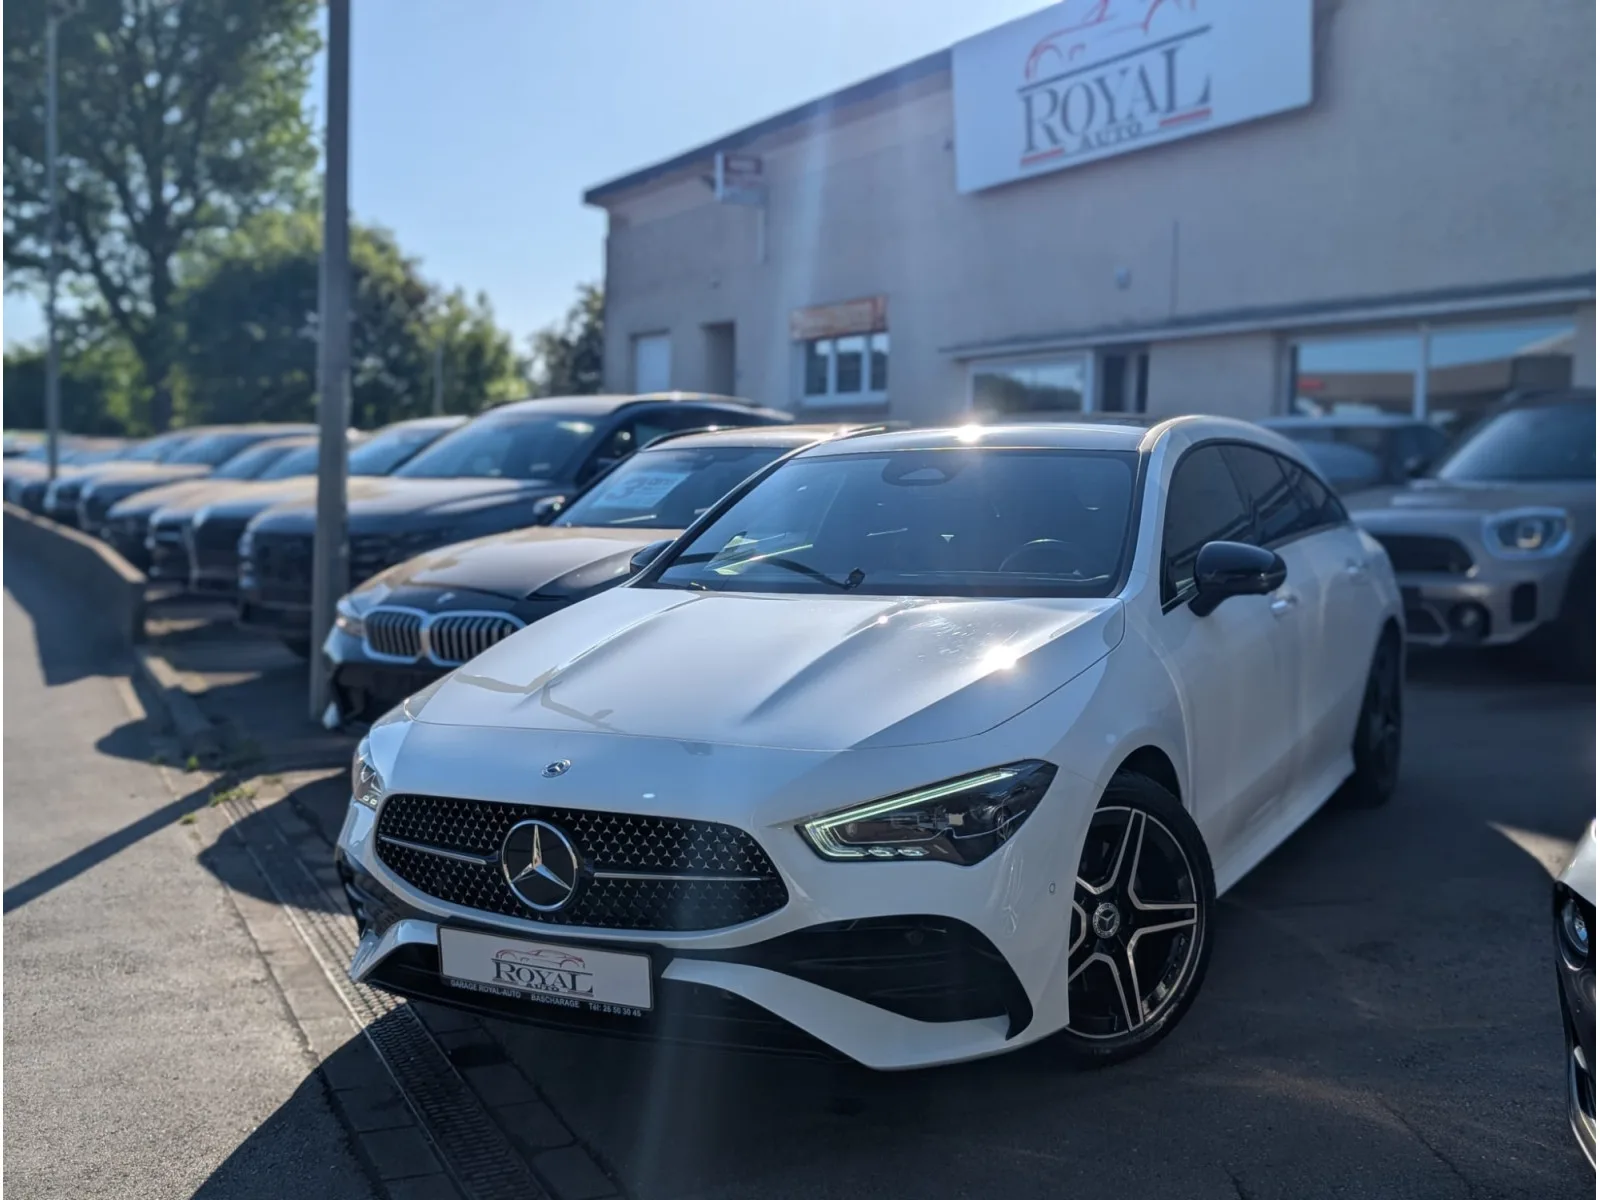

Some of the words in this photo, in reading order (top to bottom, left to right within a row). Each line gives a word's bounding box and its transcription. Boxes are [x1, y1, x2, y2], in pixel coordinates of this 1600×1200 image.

[1020, 45, 1211, 153] ROYAL
[1080, 121, 1143, 151] AUTO
[494, 961, 593, 994] ROYAL
[451, 980, 478, 991] GARAGE
[478, 985, 521, 998] ROYAL-AUTO
[531, 994, 580, 1008] BASCHARAGE
